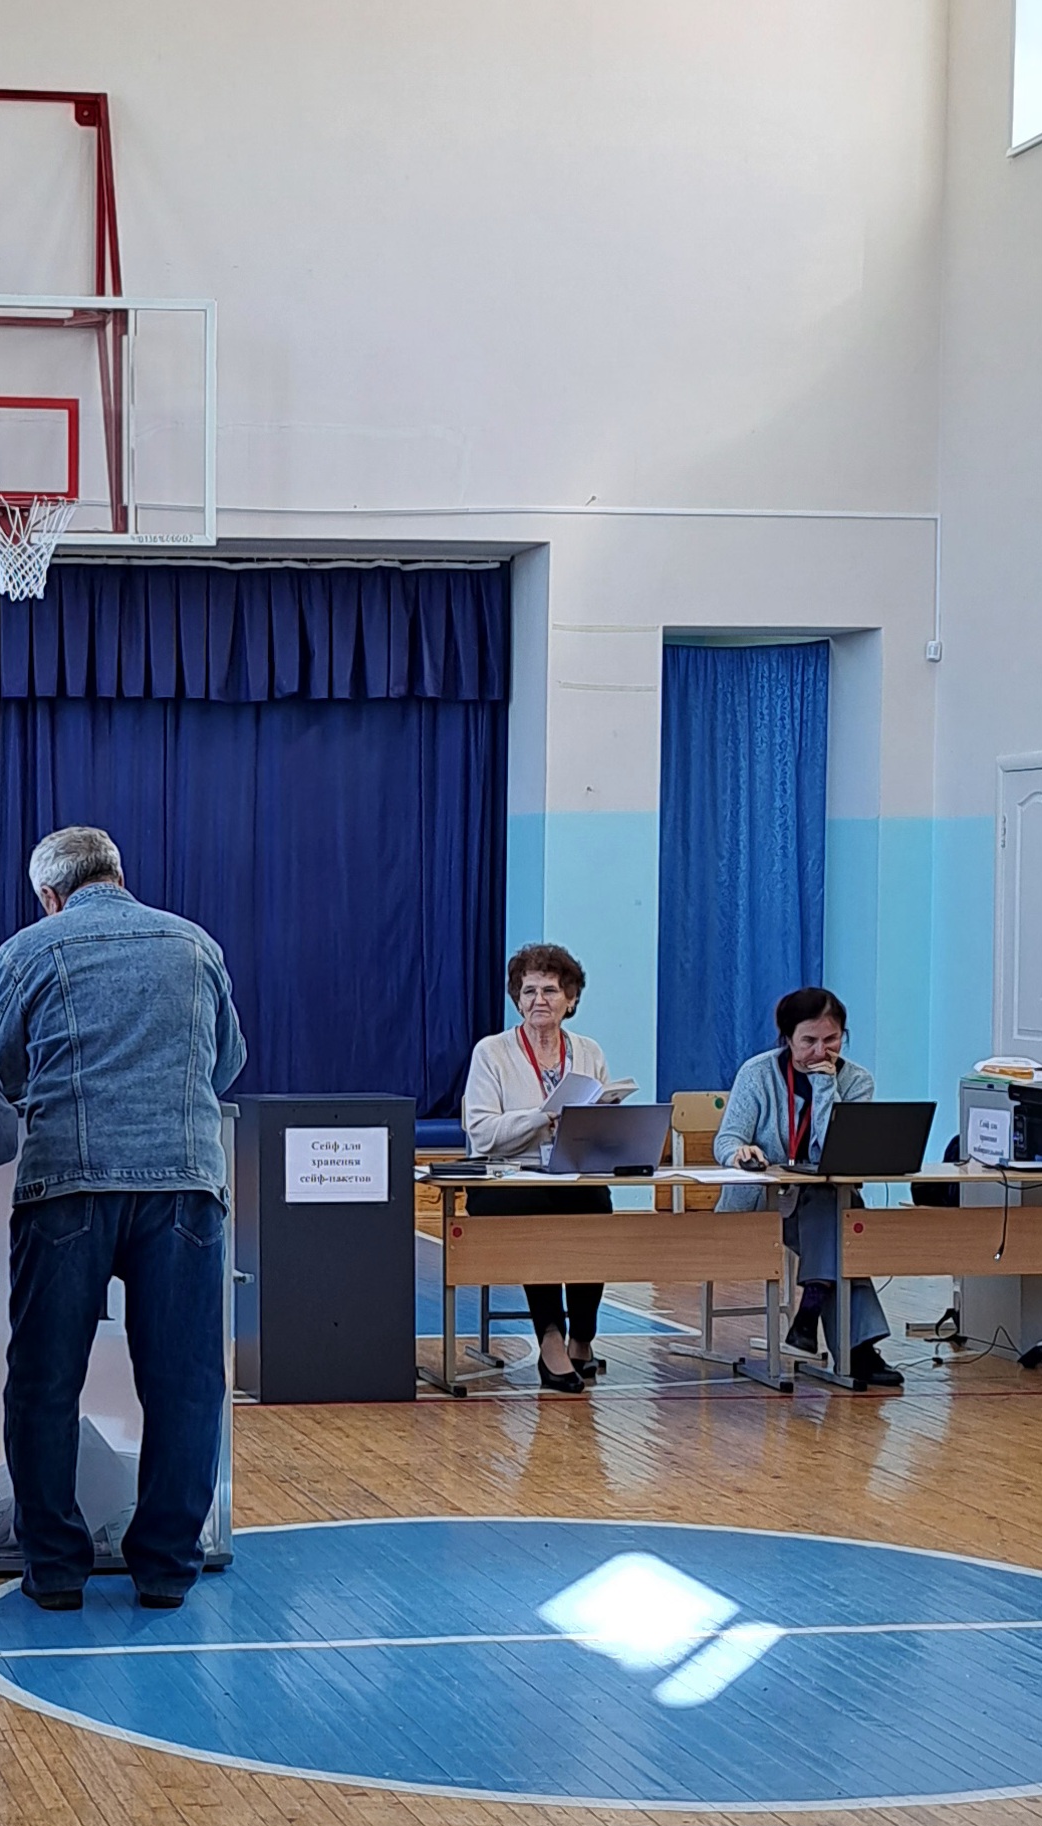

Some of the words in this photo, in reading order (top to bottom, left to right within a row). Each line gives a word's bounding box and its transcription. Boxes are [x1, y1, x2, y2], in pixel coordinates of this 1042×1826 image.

[311, 1141, 339, 1152] Сейф
[311, 1159, 361, 1168] хранения
[300, 1174, 371, 1185] сейф-пакетов
